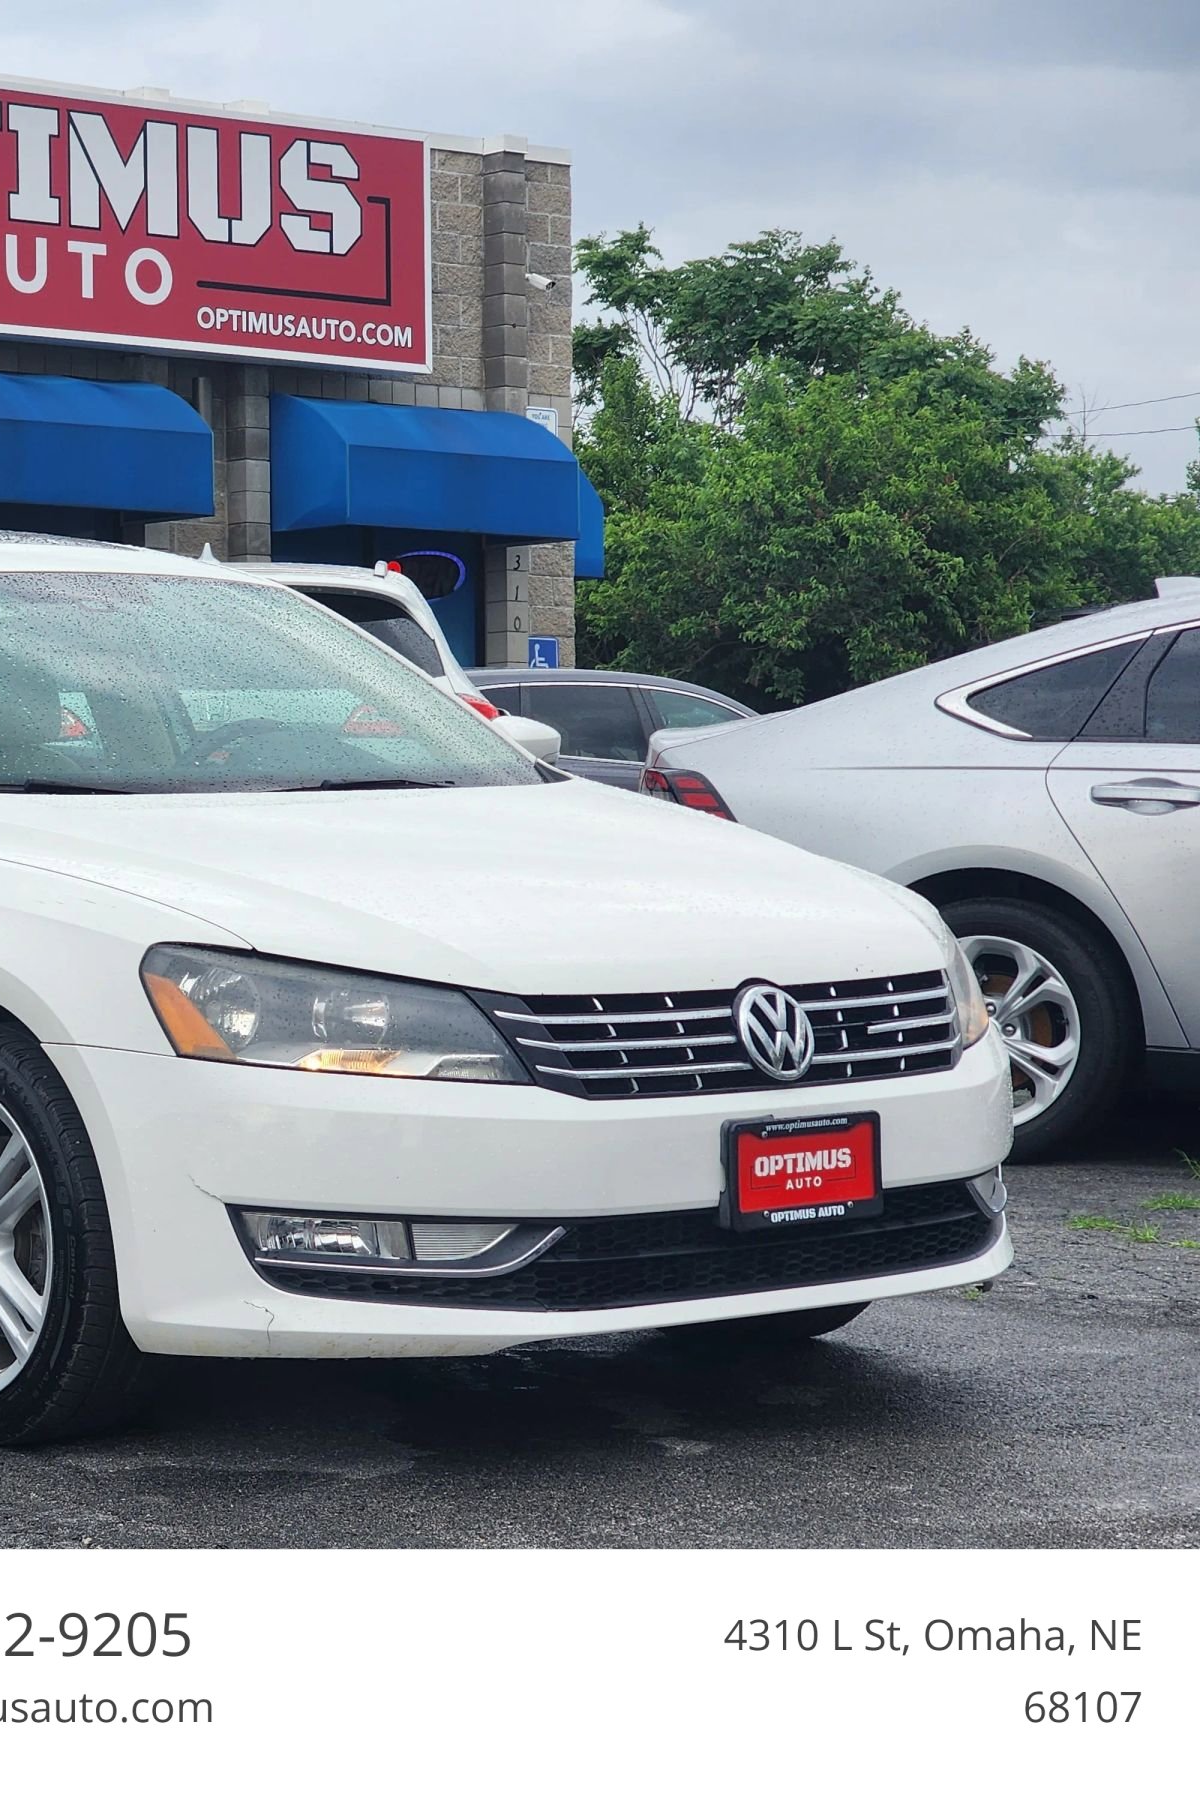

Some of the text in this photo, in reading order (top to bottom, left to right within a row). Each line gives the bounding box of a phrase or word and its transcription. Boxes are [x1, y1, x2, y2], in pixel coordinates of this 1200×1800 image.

[195, 305, 413, 349] OPTIMUSAUTO.COM
[764, 1117, 848, 1132] www.optimusauto.com
[754, 1147, 852, 1177] OPTIMUS
[785, 1176, 822, 1190] AUTO
[770, 1204, 845, 1223] OPTIMUS AUTO
